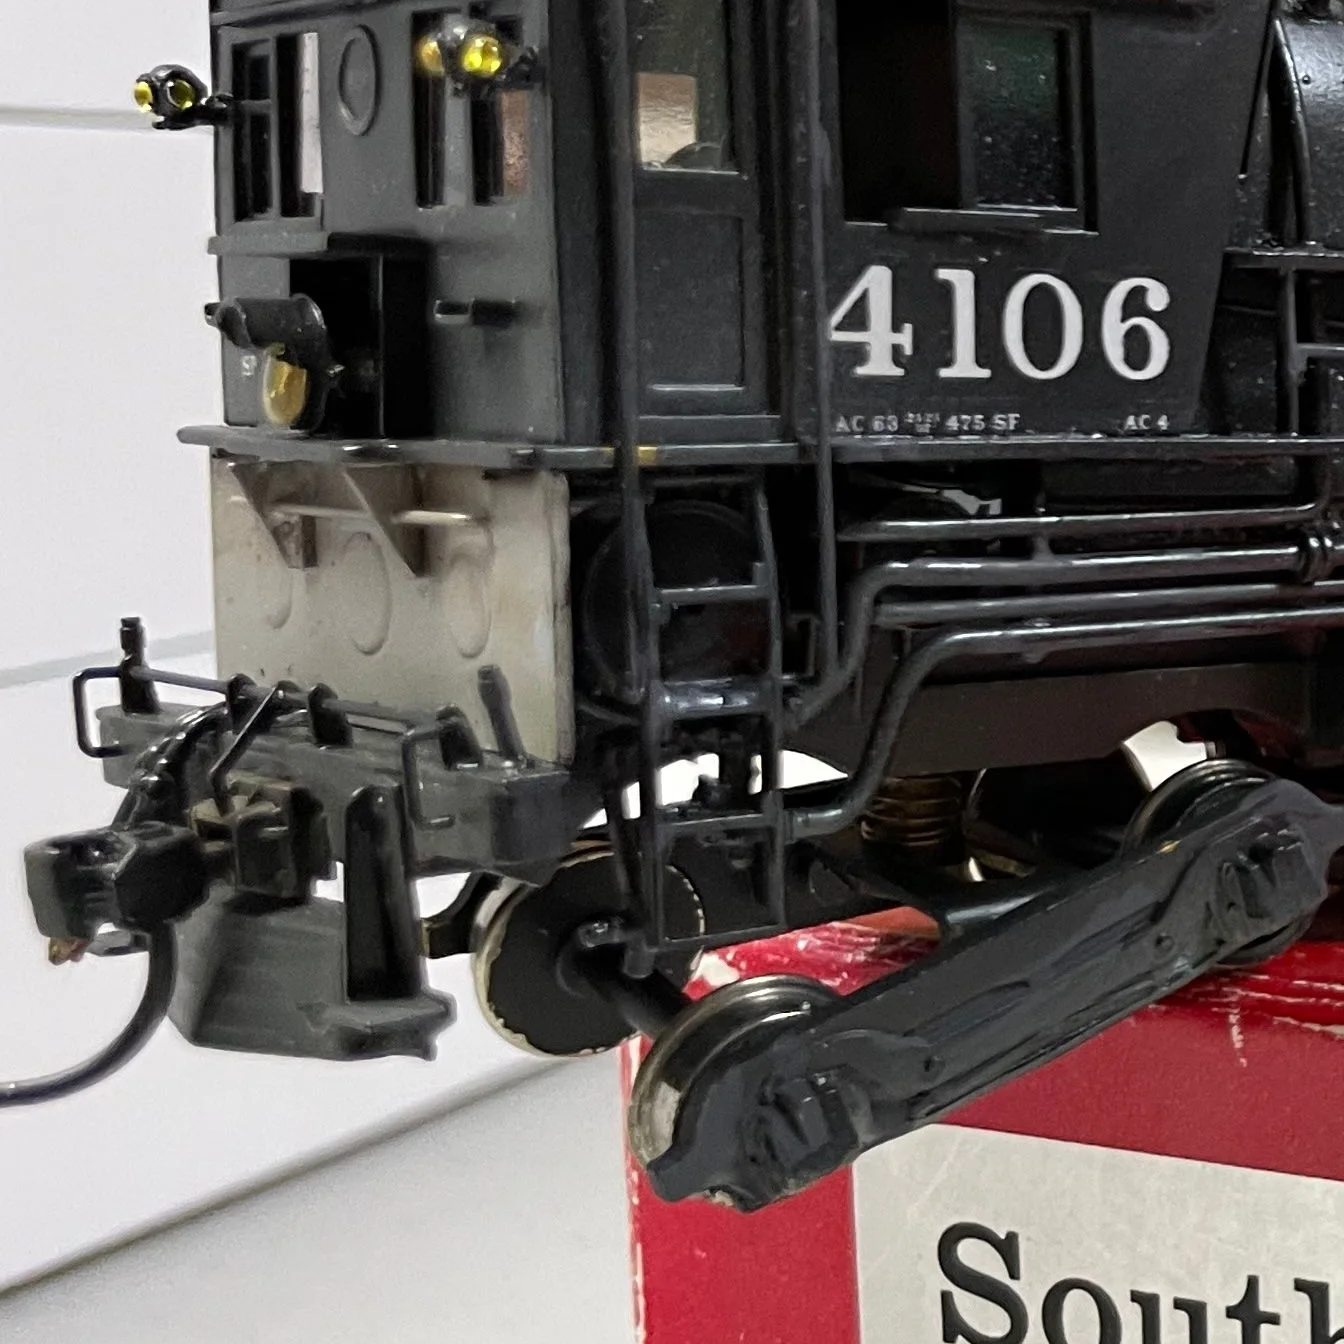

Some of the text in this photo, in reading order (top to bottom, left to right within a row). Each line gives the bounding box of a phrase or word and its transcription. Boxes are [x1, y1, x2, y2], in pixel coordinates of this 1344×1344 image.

[829, 264, 1171, 381] 4106
[835, 415, 864, 433] AC
[873, 415, 898, 432] 63
[946, 414, 986, 431] 475
[992, 413, 1021, 431] SF
[1124, 414, 1170, 432] AC 4
